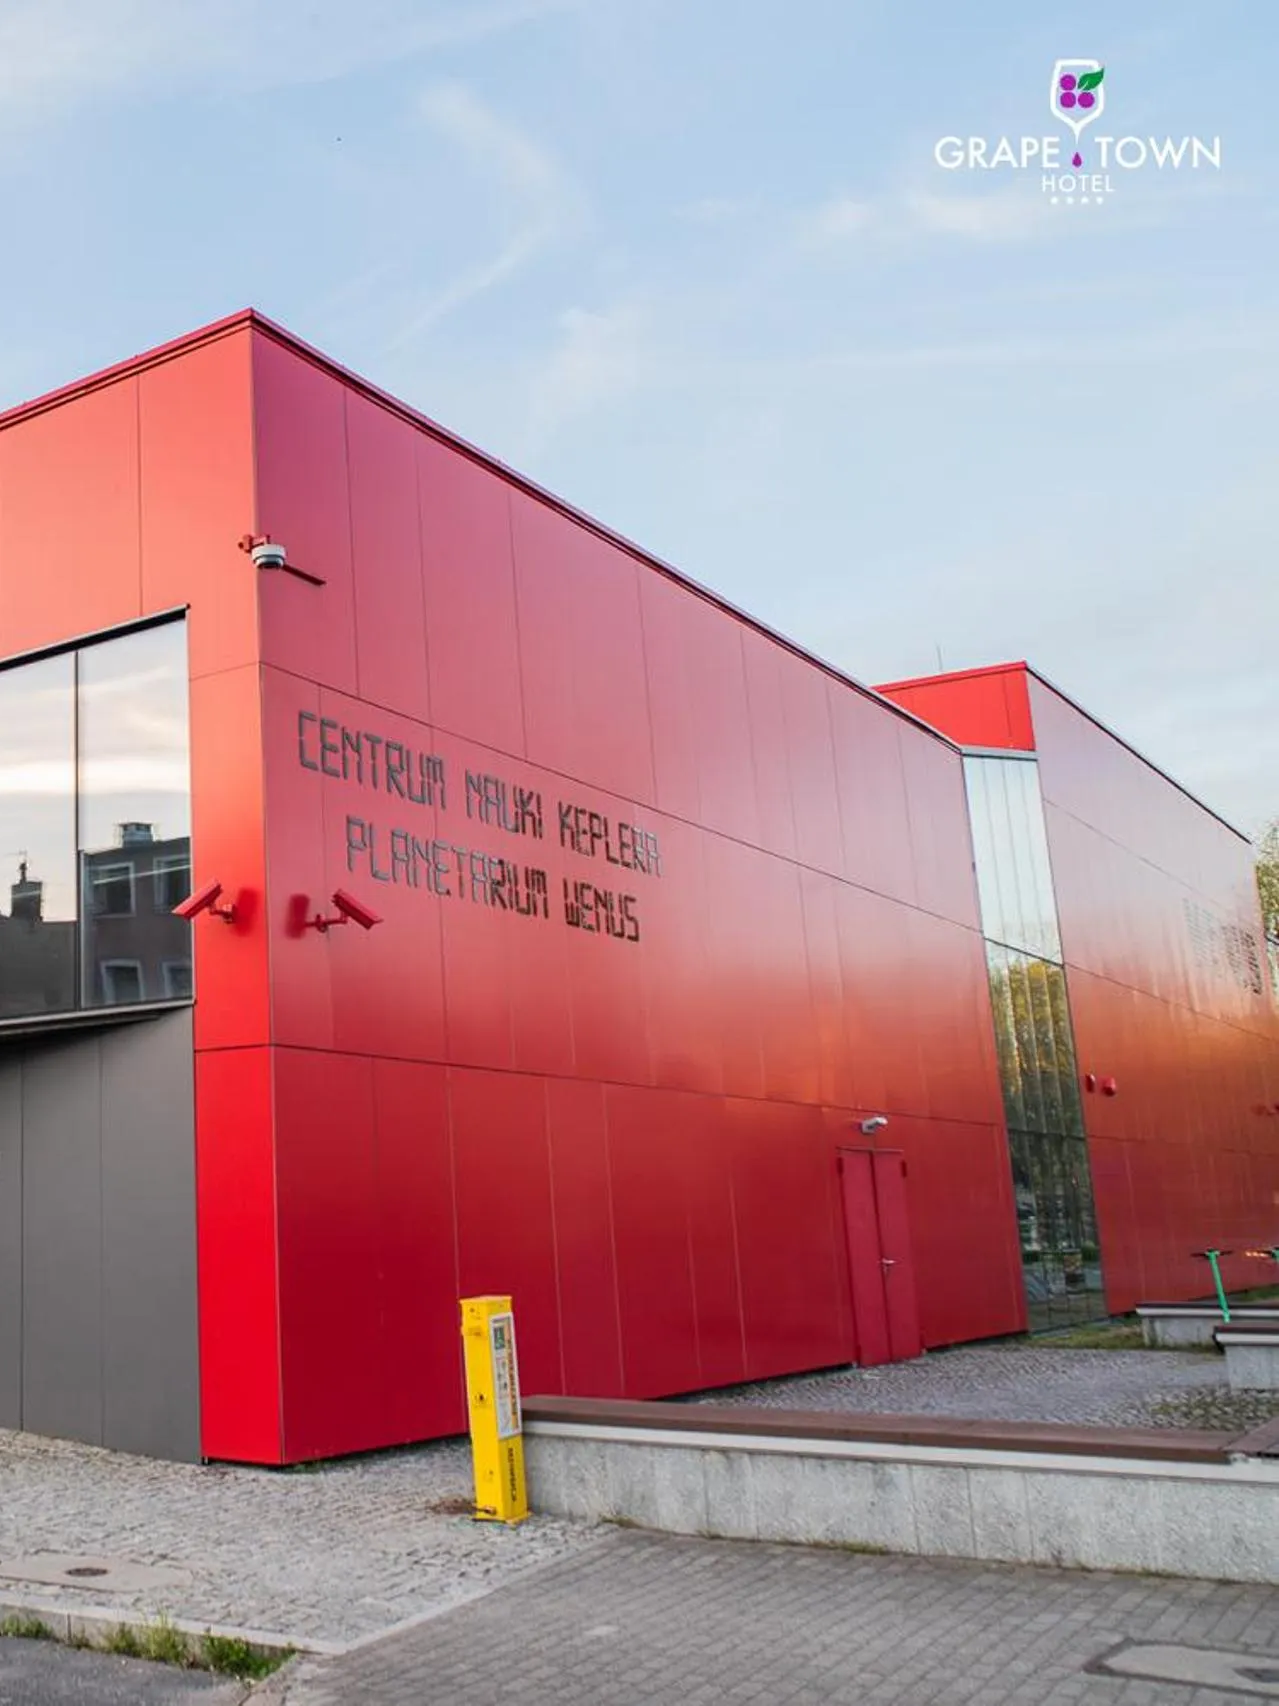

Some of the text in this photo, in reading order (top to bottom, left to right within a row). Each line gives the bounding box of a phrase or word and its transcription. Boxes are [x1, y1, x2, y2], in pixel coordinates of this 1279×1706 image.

[297, 709, 662, 879] CENTRUM NAUKI KEPLERA
[346, 814, 640, 943] PLANETARIUM WENUS
